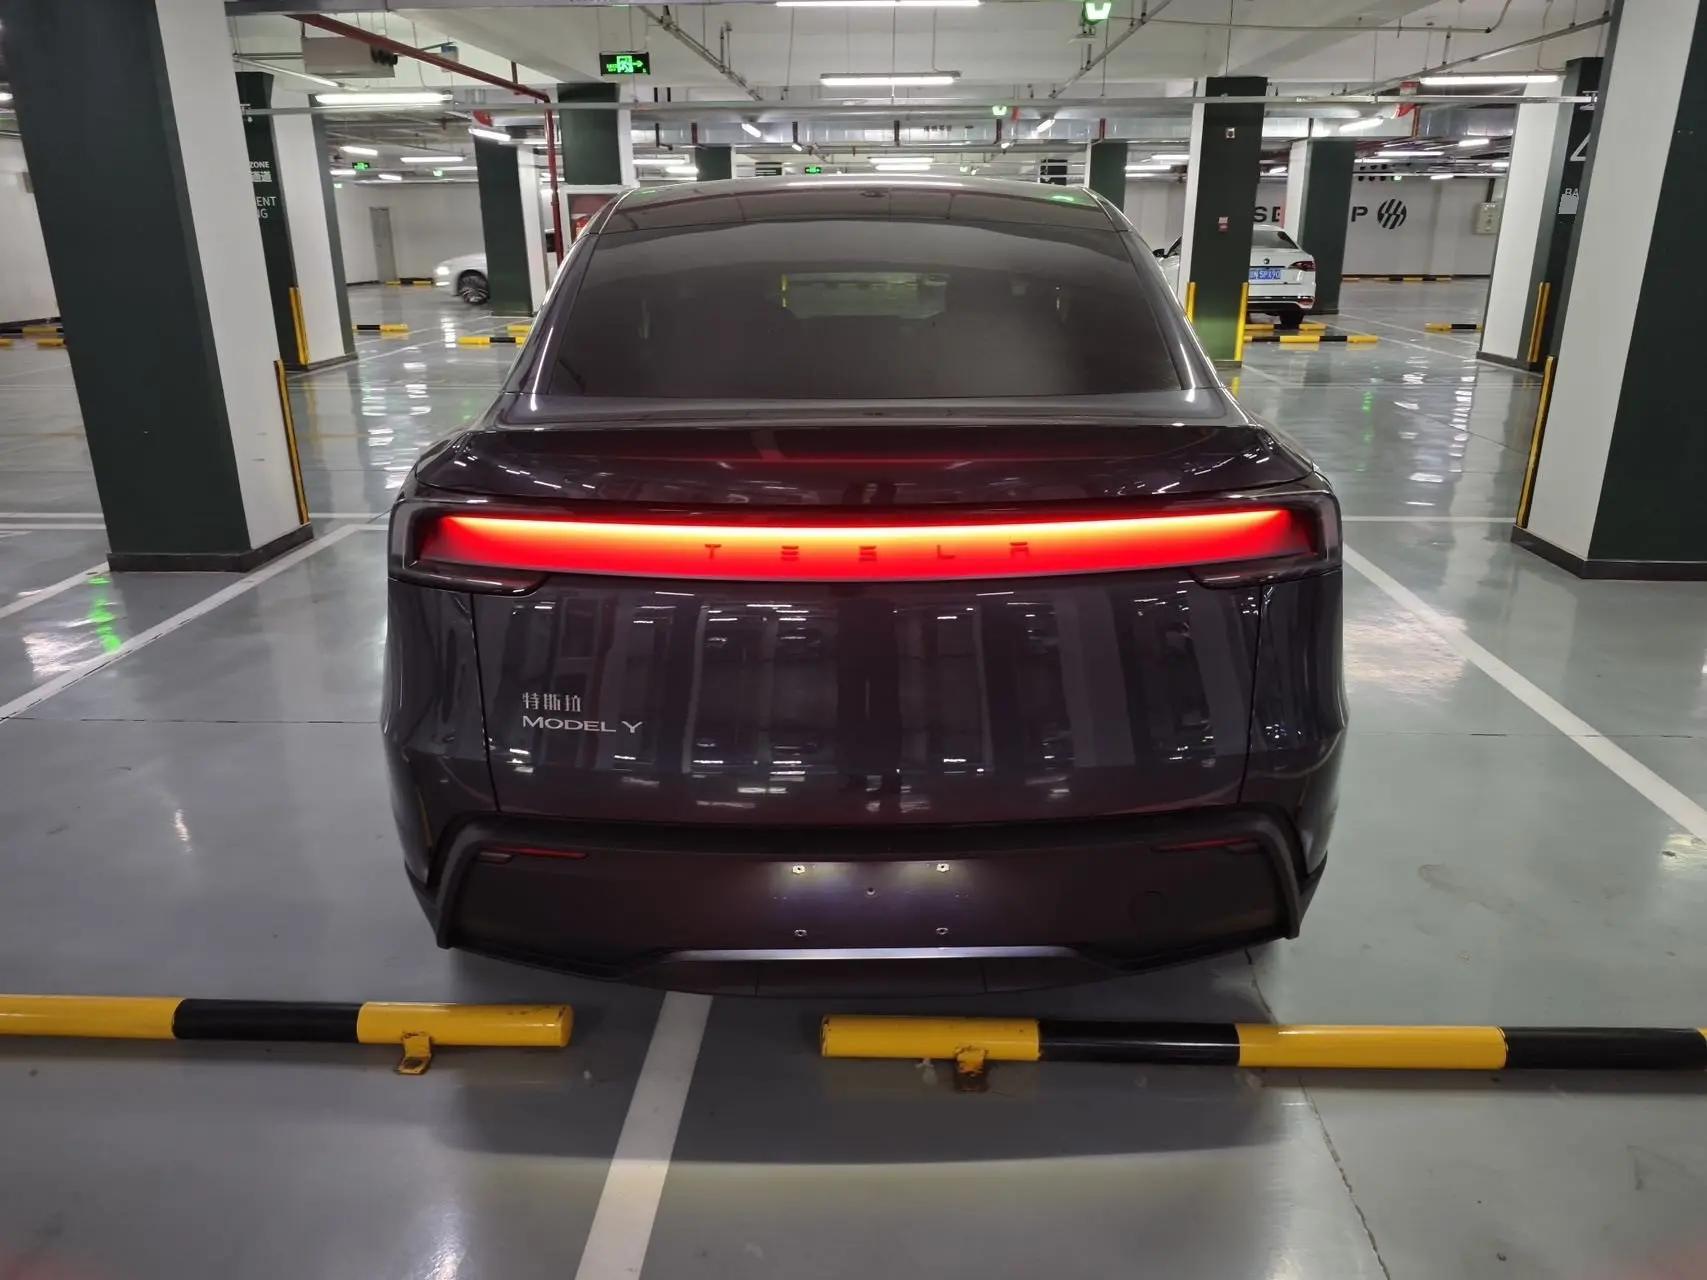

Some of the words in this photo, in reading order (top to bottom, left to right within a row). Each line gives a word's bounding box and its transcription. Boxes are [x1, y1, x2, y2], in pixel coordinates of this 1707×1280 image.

[256, 196, 277, 206] ENT
[704, 541, 1029, 562] TESLA
[522, 692, 581, 712] 特斯拉
[522, 715, 617, 733] MODEL
[621, 720, 643, 734] Y
